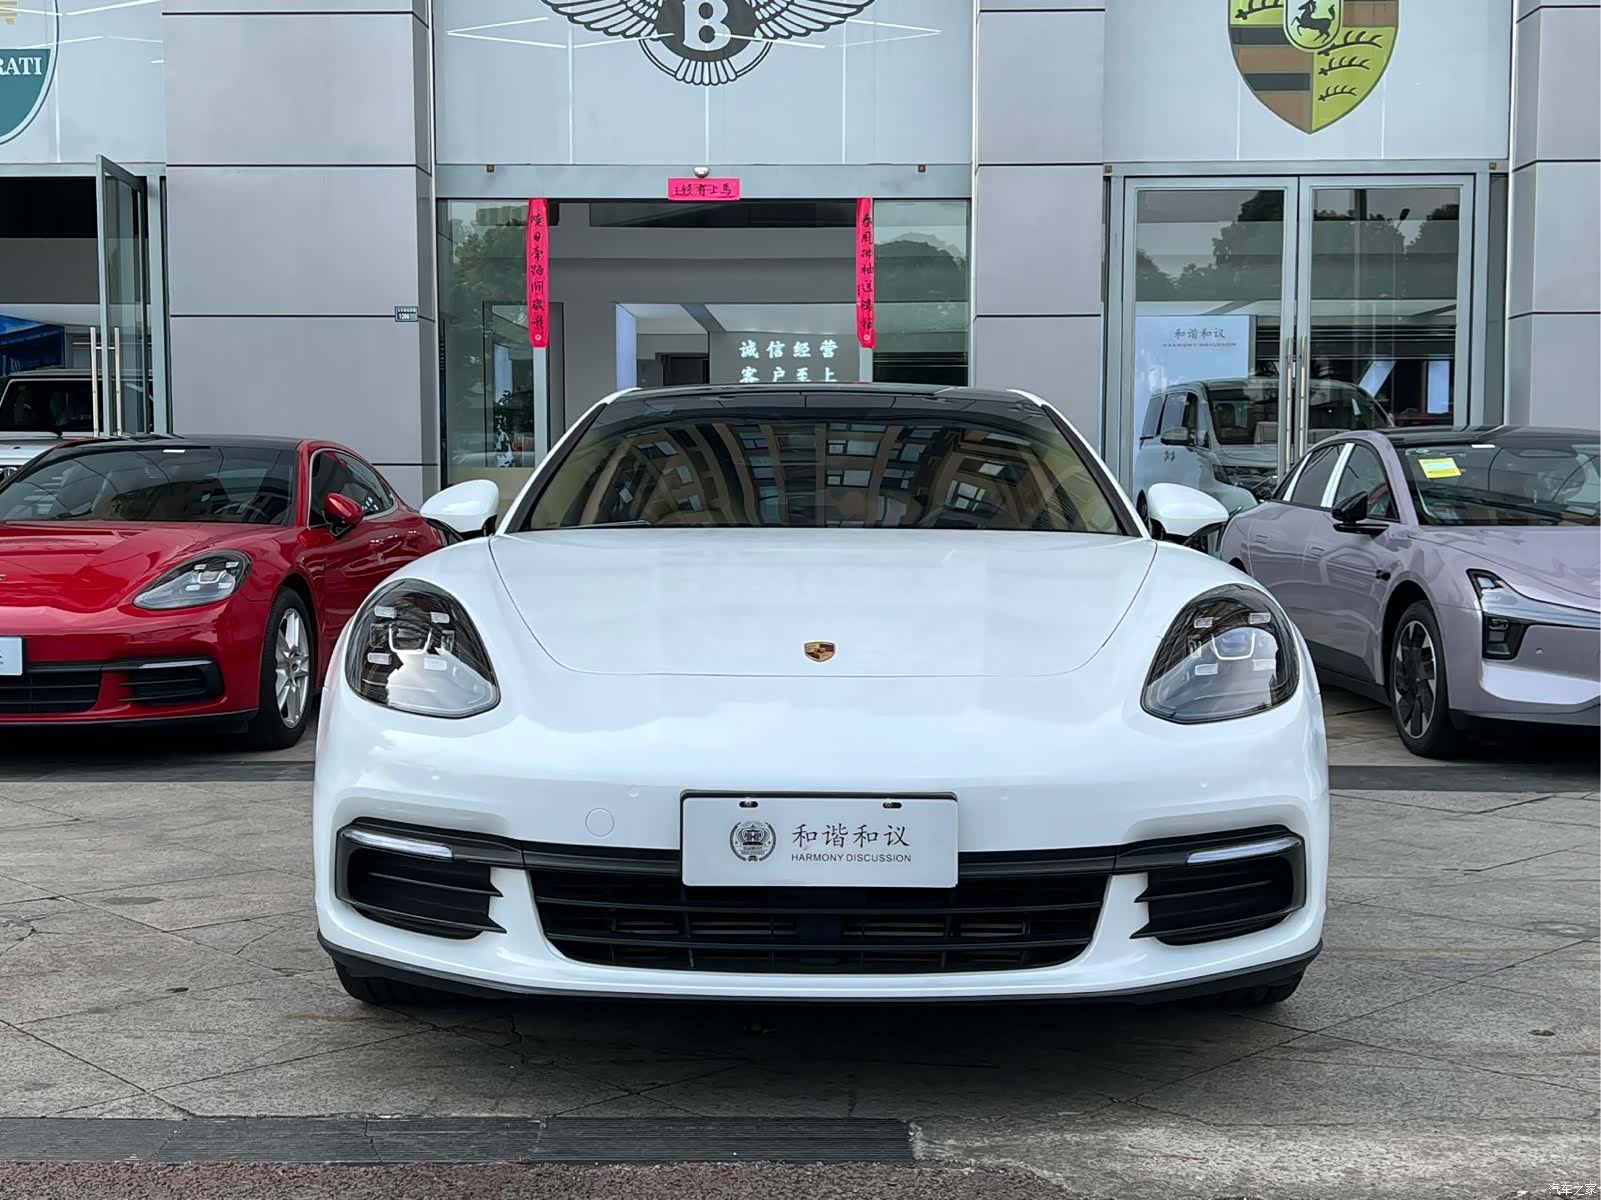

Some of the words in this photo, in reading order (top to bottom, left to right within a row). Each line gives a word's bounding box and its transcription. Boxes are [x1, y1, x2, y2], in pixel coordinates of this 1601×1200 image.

[1174, 328, 1226, 340] 和谐和议
[738, 339, 838, 359] 诚信经营
[738, 366, 838, 383] 客户至上
[791, 822, 911, 849] 和谐和议
[791, 853, 844, 862] HARMONY
[846, 853, 912, 863] DISCUSSION
